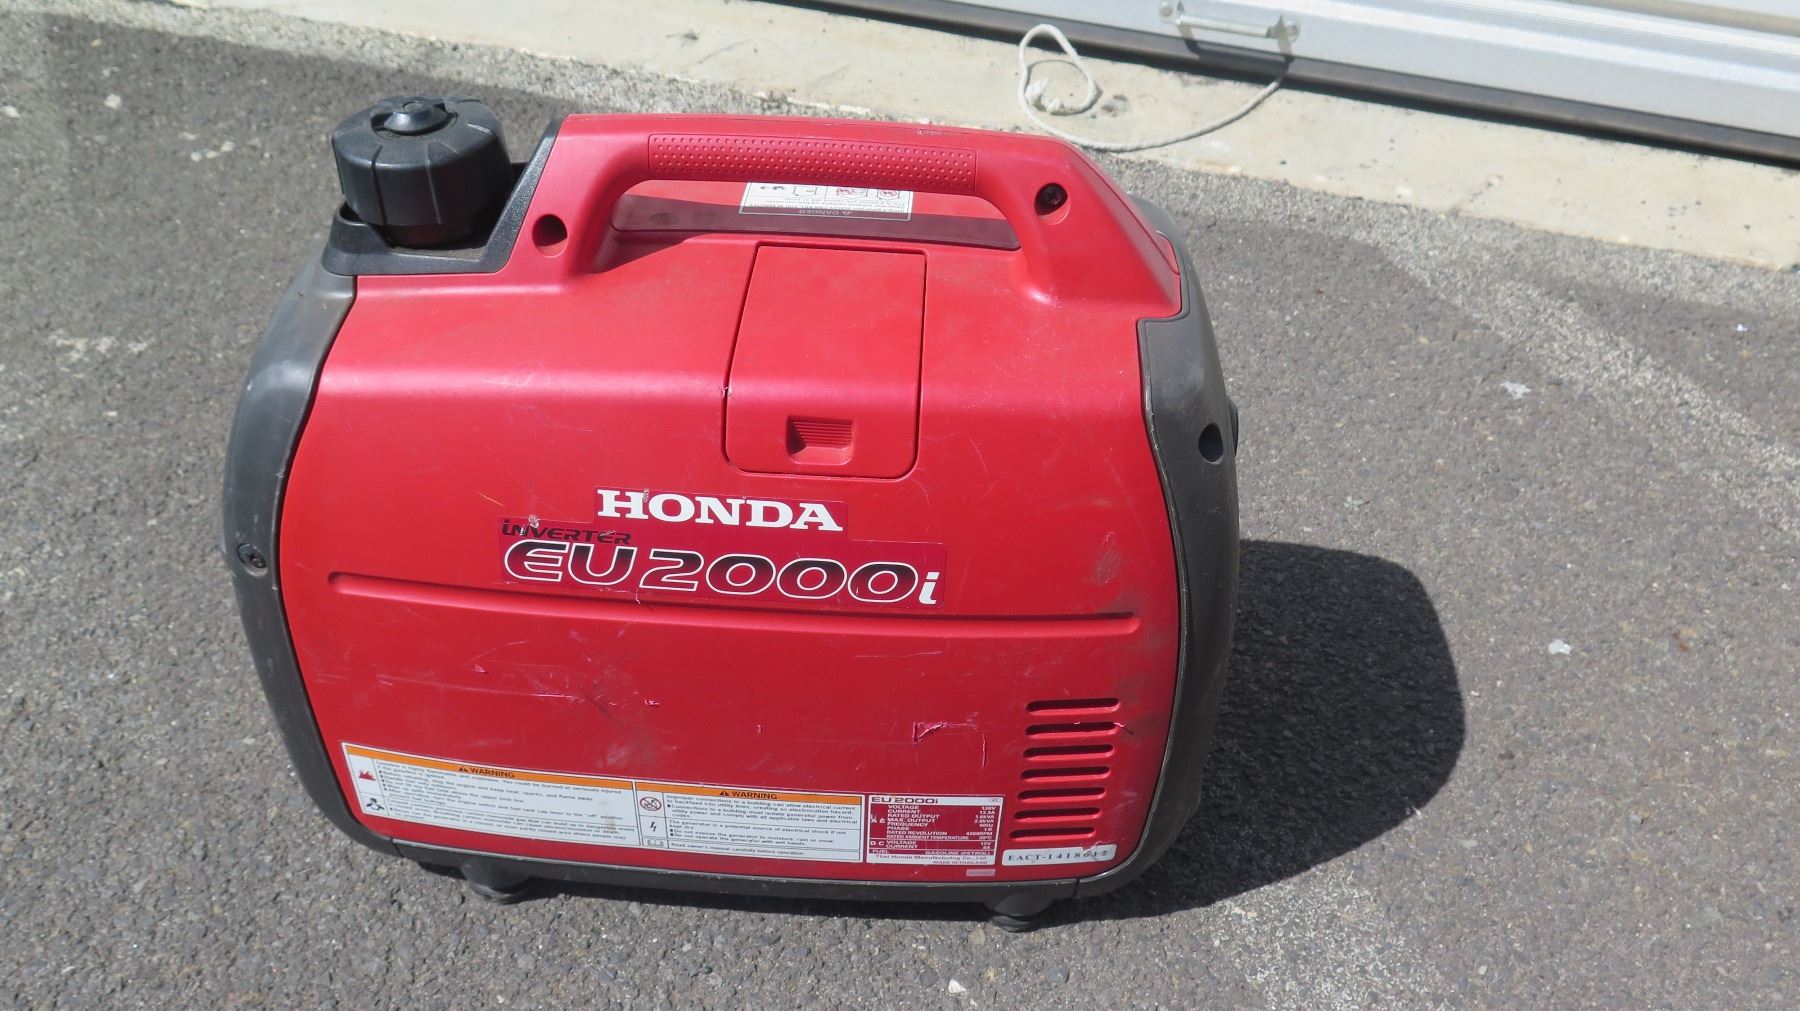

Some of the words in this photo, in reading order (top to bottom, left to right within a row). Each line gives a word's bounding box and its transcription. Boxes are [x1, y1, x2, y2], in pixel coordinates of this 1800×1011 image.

[597, 488, 844, 531] HONDA
[470, 767, 515, 778] WARNING
[732, 792, 778, 800] WARNING
